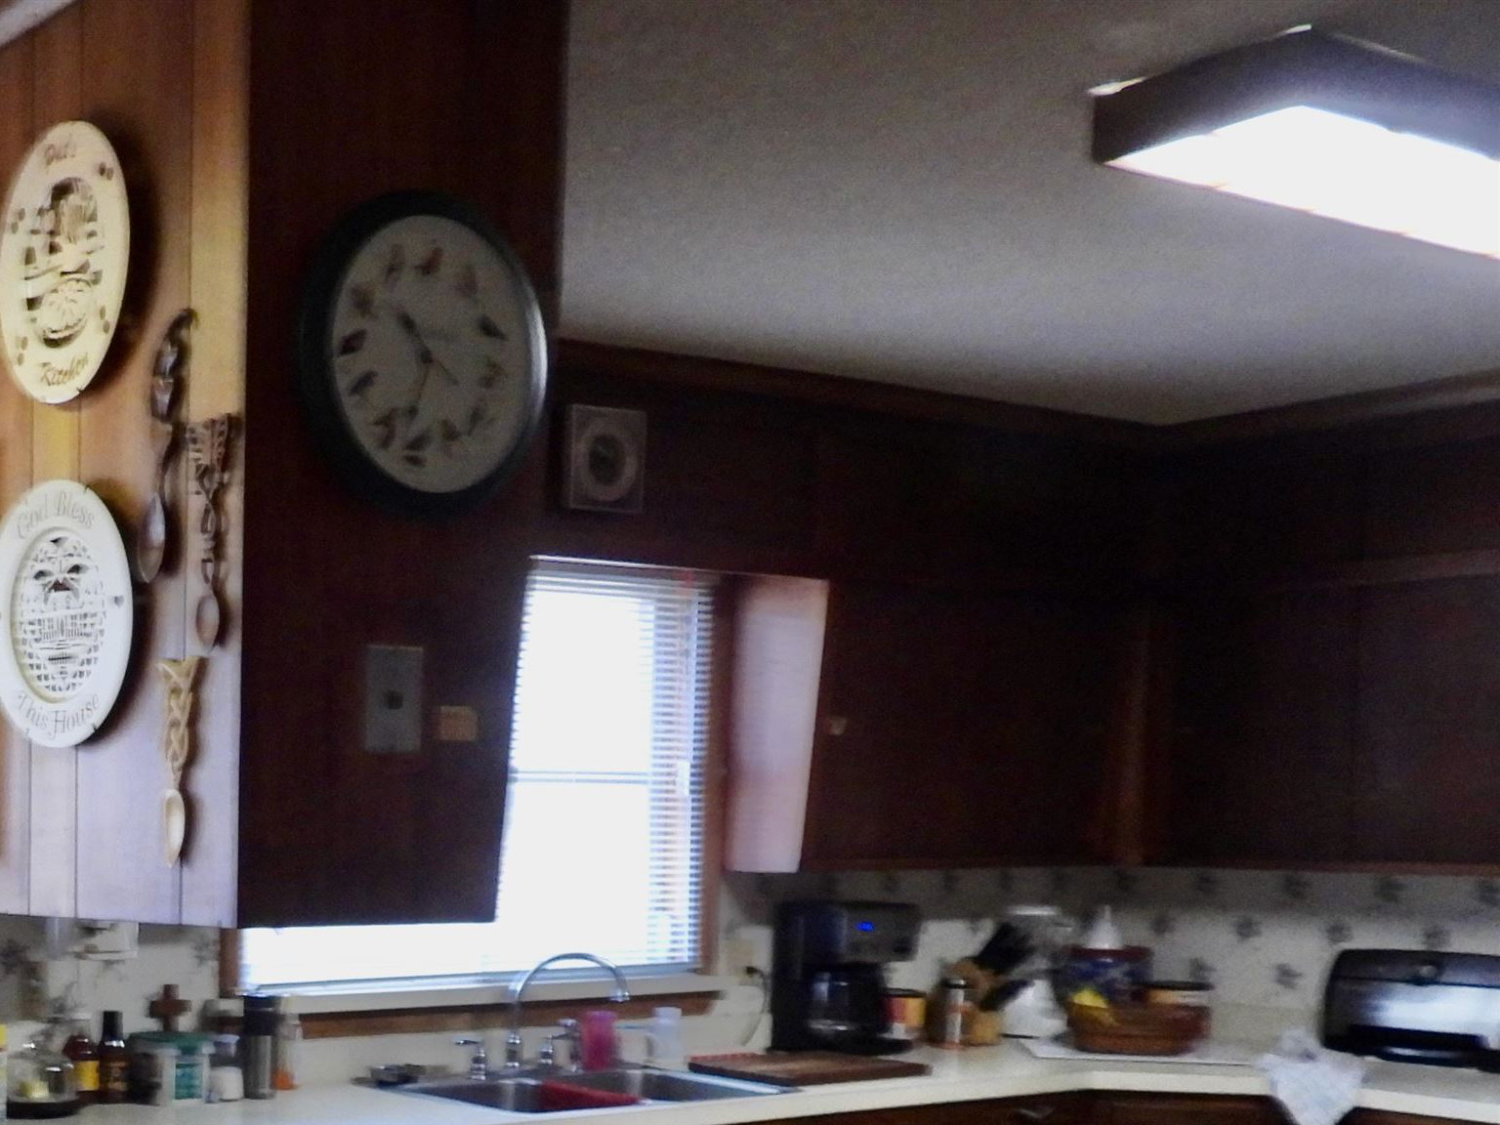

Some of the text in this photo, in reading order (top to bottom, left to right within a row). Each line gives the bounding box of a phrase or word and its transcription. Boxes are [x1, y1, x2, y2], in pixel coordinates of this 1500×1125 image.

[40, 354, 89, 386] Kitchen
[17, 490, 95, 539] God Bless
[18, 692, 99, 740] This House
